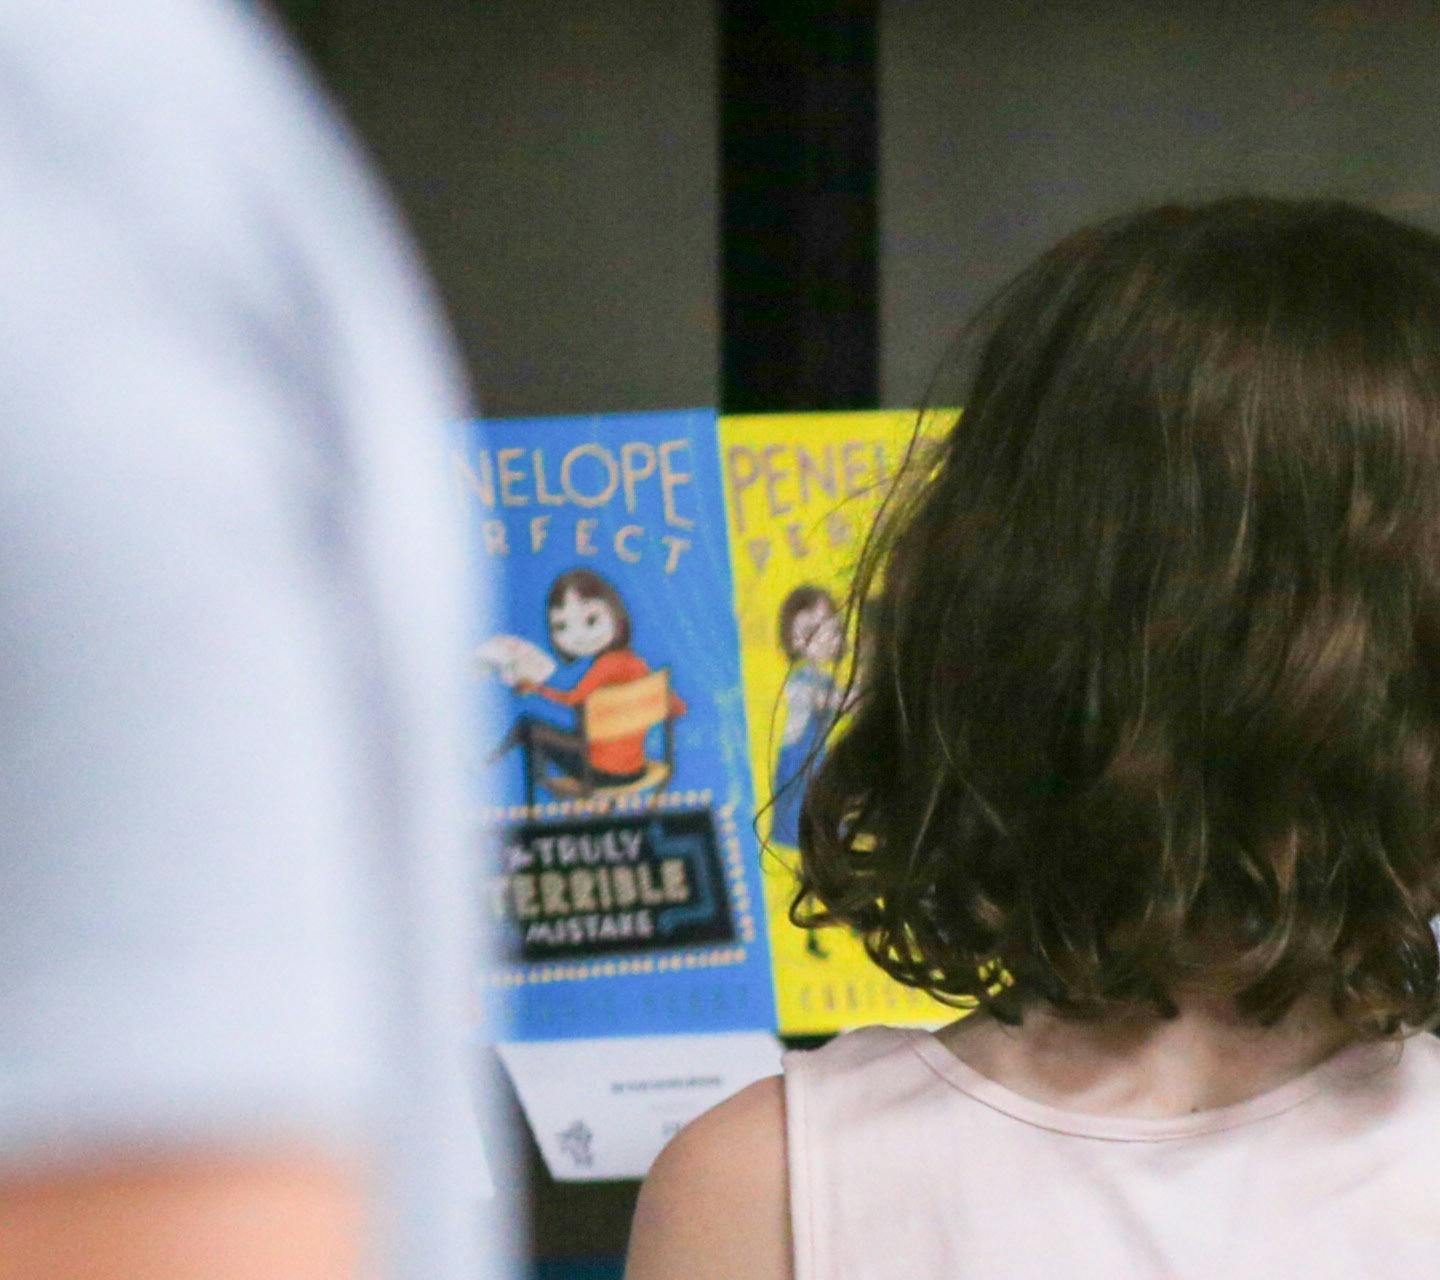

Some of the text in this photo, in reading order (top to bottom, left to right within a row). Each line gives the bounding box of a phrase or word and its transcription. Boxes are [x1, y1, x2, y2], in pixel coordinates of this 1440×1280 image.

[453, 438, 694, 530] NELOPE
[481, 514, 693, 575] RFECT
[532, 829, 644, 868] TRULY
[525, 907, 656, 945] MISTAKE
